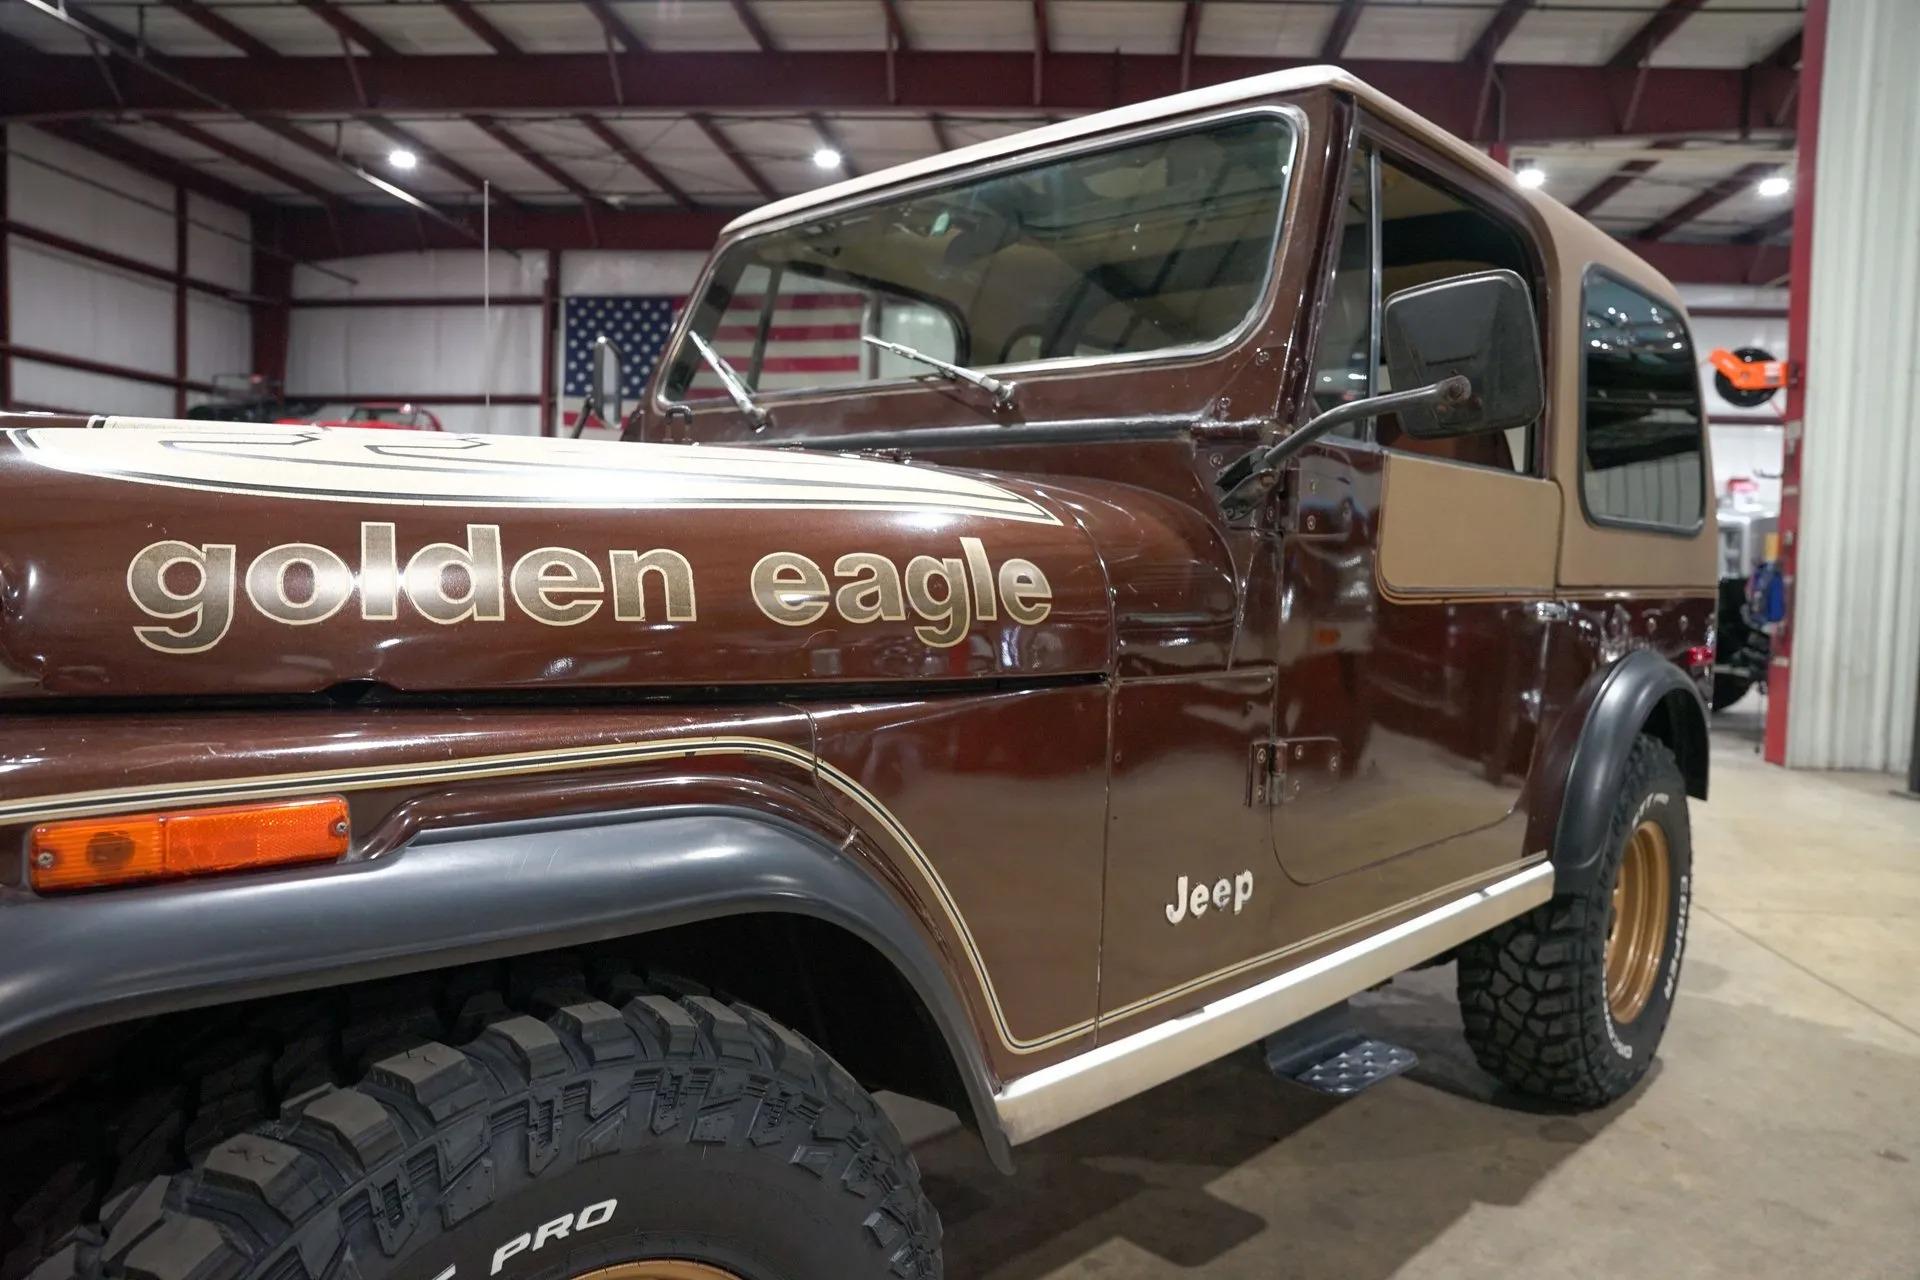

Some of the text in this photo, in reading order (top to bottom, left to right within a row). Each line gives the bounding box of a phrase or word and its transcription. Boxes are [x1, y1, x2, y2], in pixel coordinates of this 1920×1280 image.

[127, 521, 1053, 655] golden eagle
[1165, 870, 1254, 924] Jeep
[490, 1198, 618, 1276] PRO
